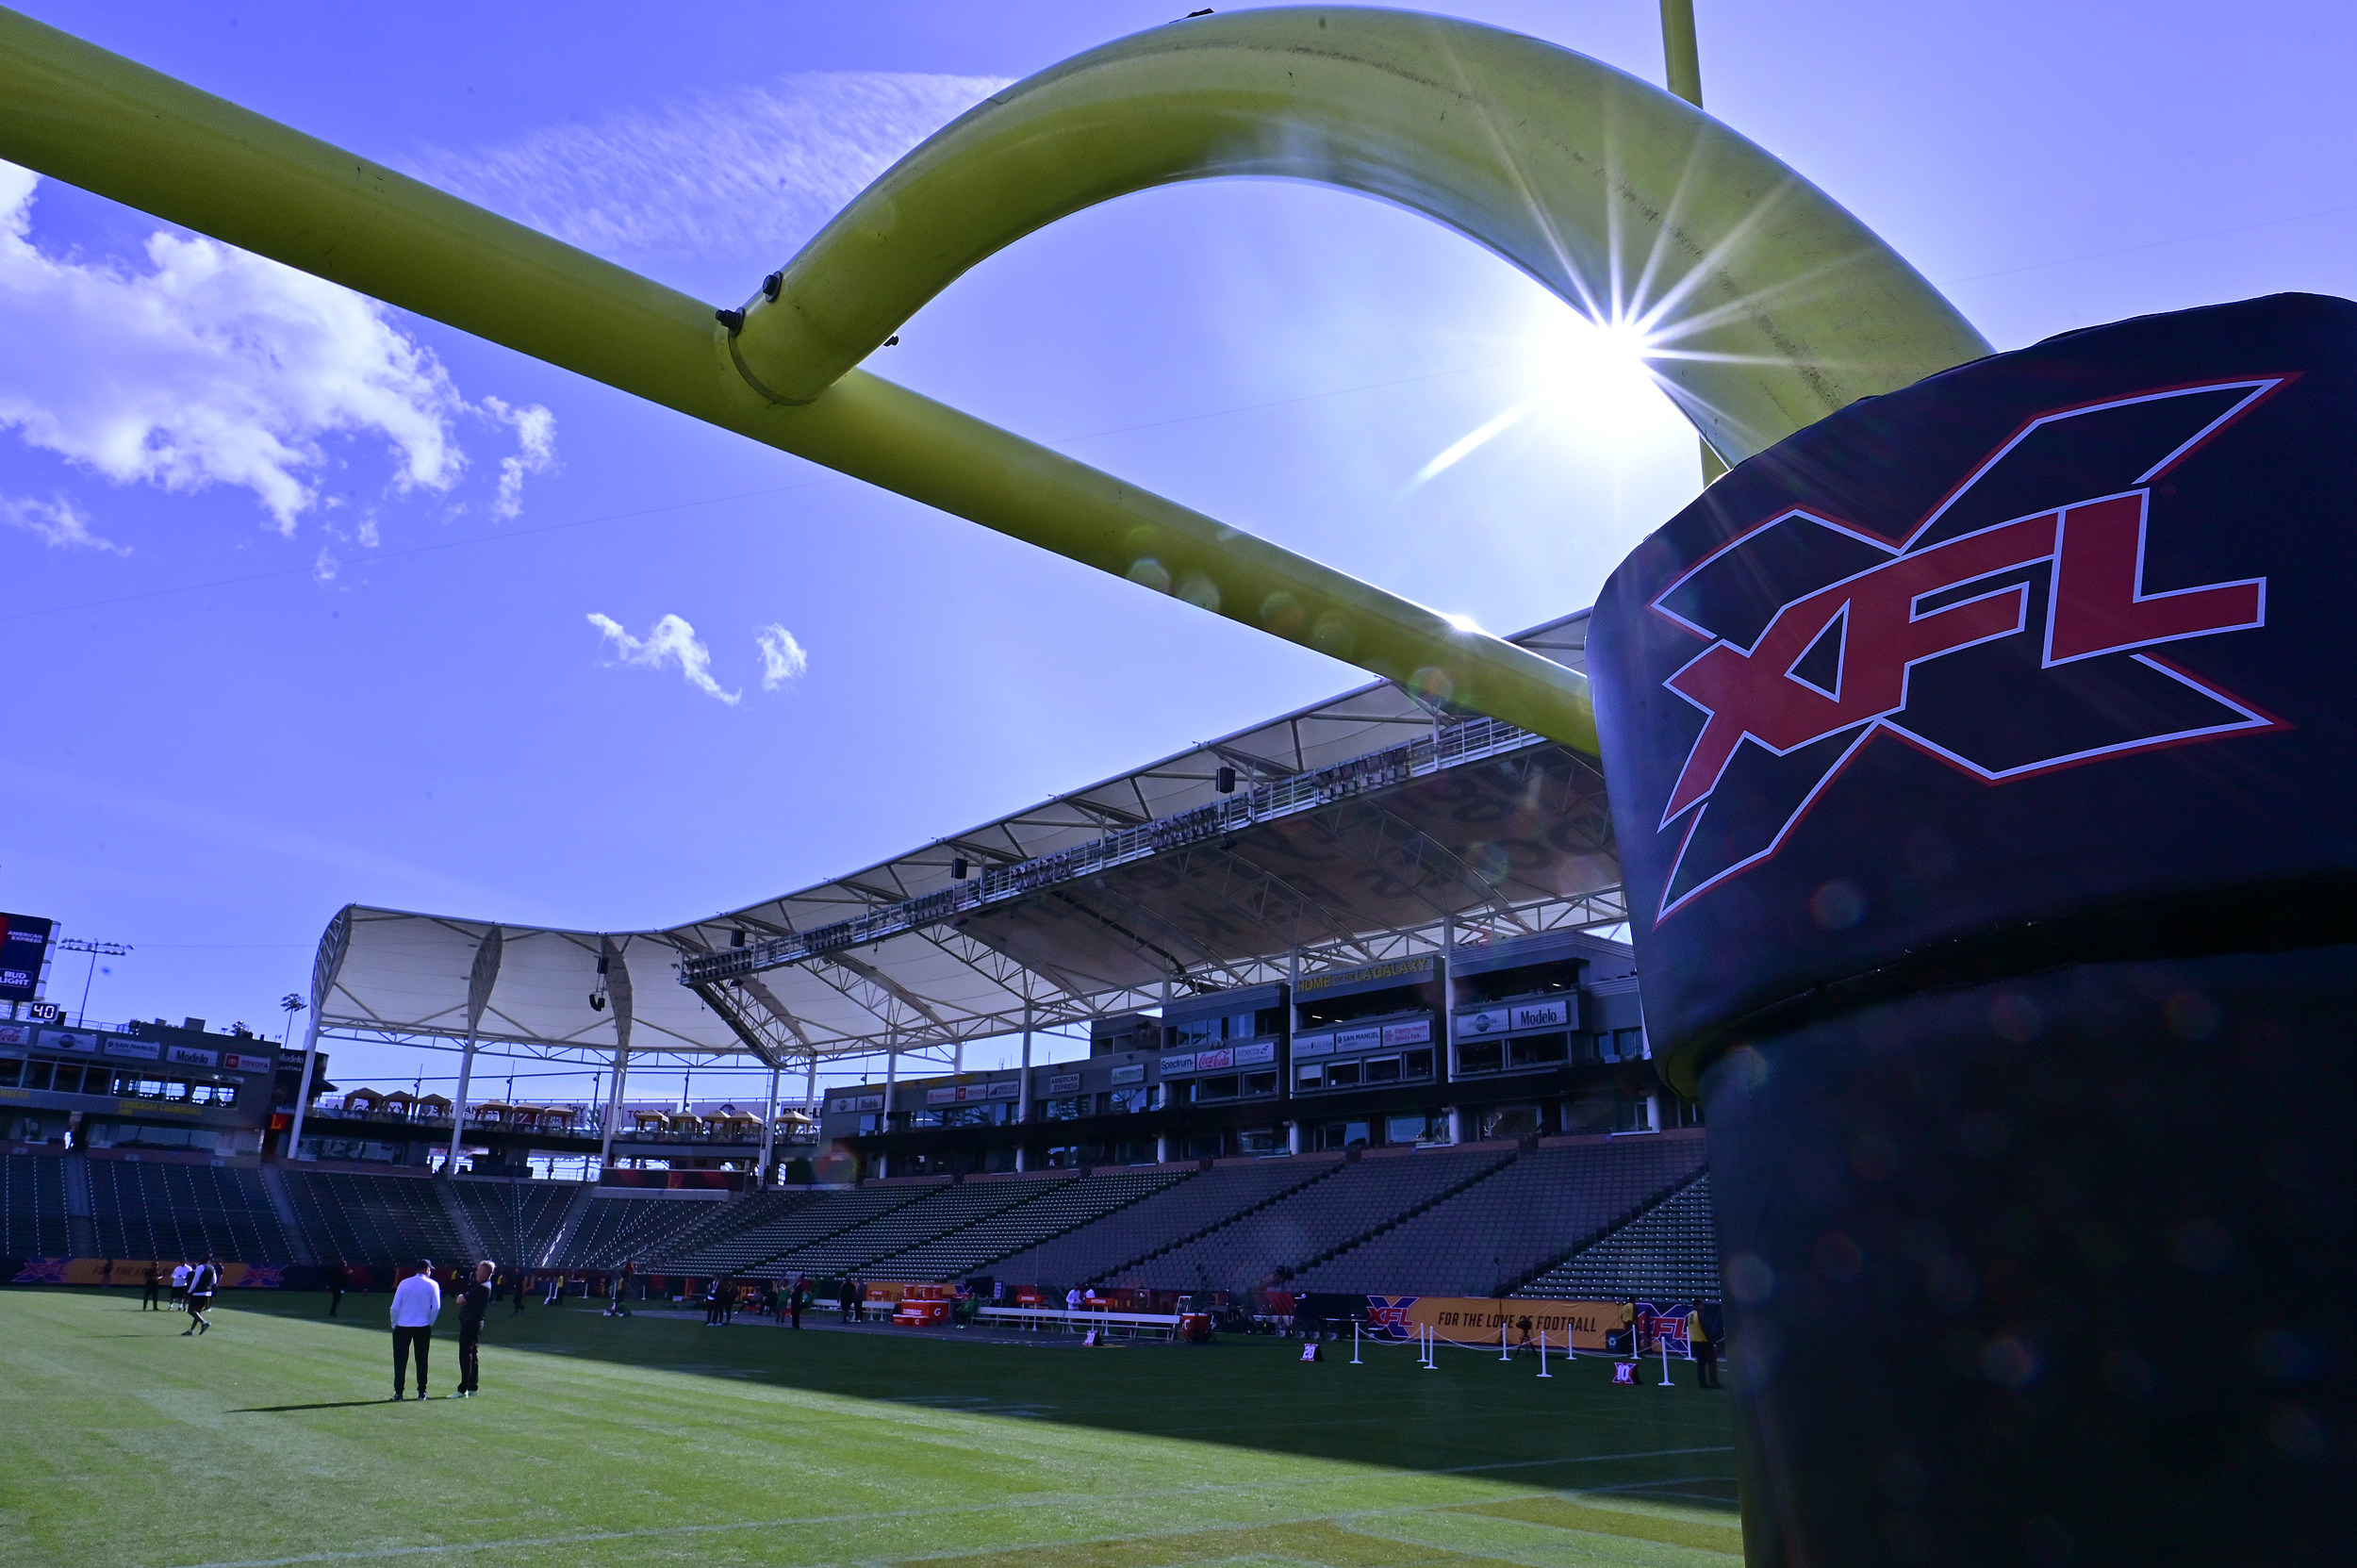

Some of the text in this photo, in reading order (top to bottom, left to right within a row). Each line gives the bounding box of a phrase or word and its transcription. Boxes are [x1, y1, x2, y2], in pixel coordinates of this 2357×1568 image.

[1656, 487, 2267, 834] XFL
[8, 931, 43, 939] AMERICAN
[4, 970, 27, 980] BUD
[1297, 976, 1332, 992] HOME
[1356, 966, 1373, 982] LA
[1374, 957, 1428, 979] GALAXY
[33, 1005, 56, 1019] 40
[1521, 1008, 1558, 1027] Modelo
[1356, 1032, 1379, 1041] MANUEL
[129, 1043, 157, 1052] MANUEL
[174, 1049, 208, 1065] Modelo
[240, 1059, 270, 1069] TOYOTA
[1161, 1058, 1193, 1072] Spectrum
[1050, 1075, 1079, 1084] AMERICAN
[1053, 1082, 1079, 1091] EXPRESS
[933, 1308, 941, 1316] G
[1438, 1312, 1459, 1327] FOR
[1463, 1312, 1484, 1328] THE
[1486, 1313, 1515, 1329] LOVE
[1537, 1315, 1597, 1332] FOOTBALL
[1616, 1365, 1631, 1381] 10
